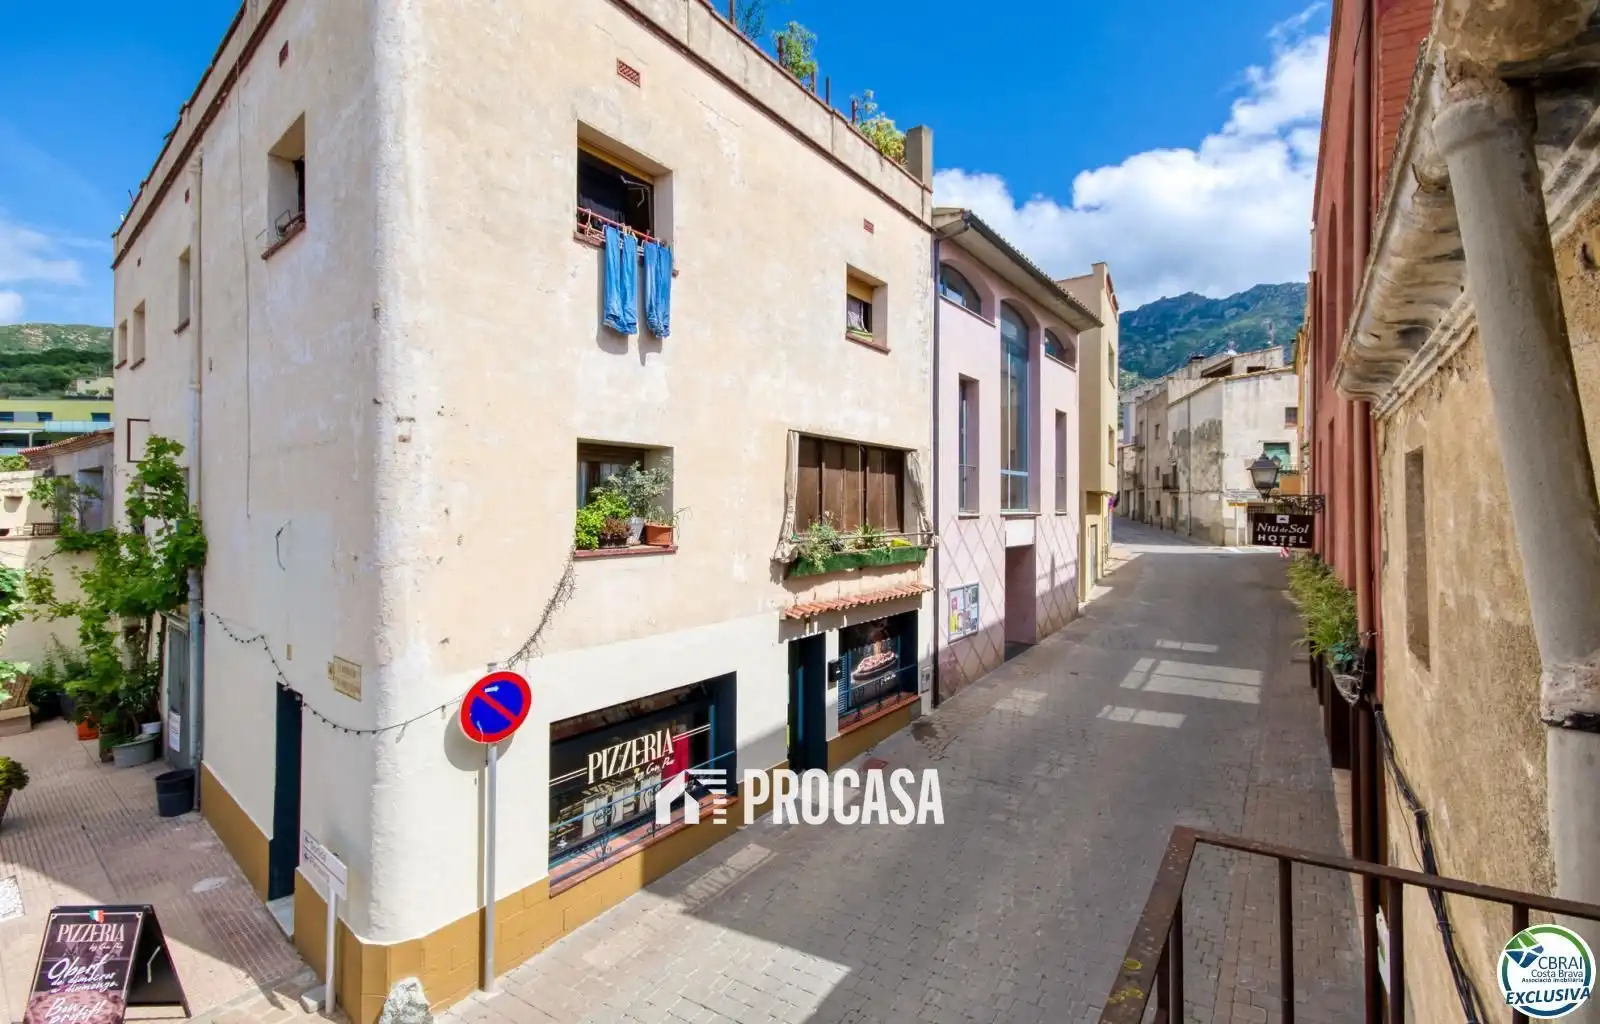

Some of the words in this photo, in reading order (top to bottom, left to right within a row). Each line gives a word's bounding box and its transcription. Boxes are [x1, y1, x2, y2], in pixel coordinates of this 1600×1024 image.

[1258, 534, 1308, 543] HOTEL
[1288, 524, 1310, 534] Sol
[587, 727, 674, 785] PIZZERIA
[56, 923, 125, 943] PIZZERIA
[48, 953, 110, 979] Obert
